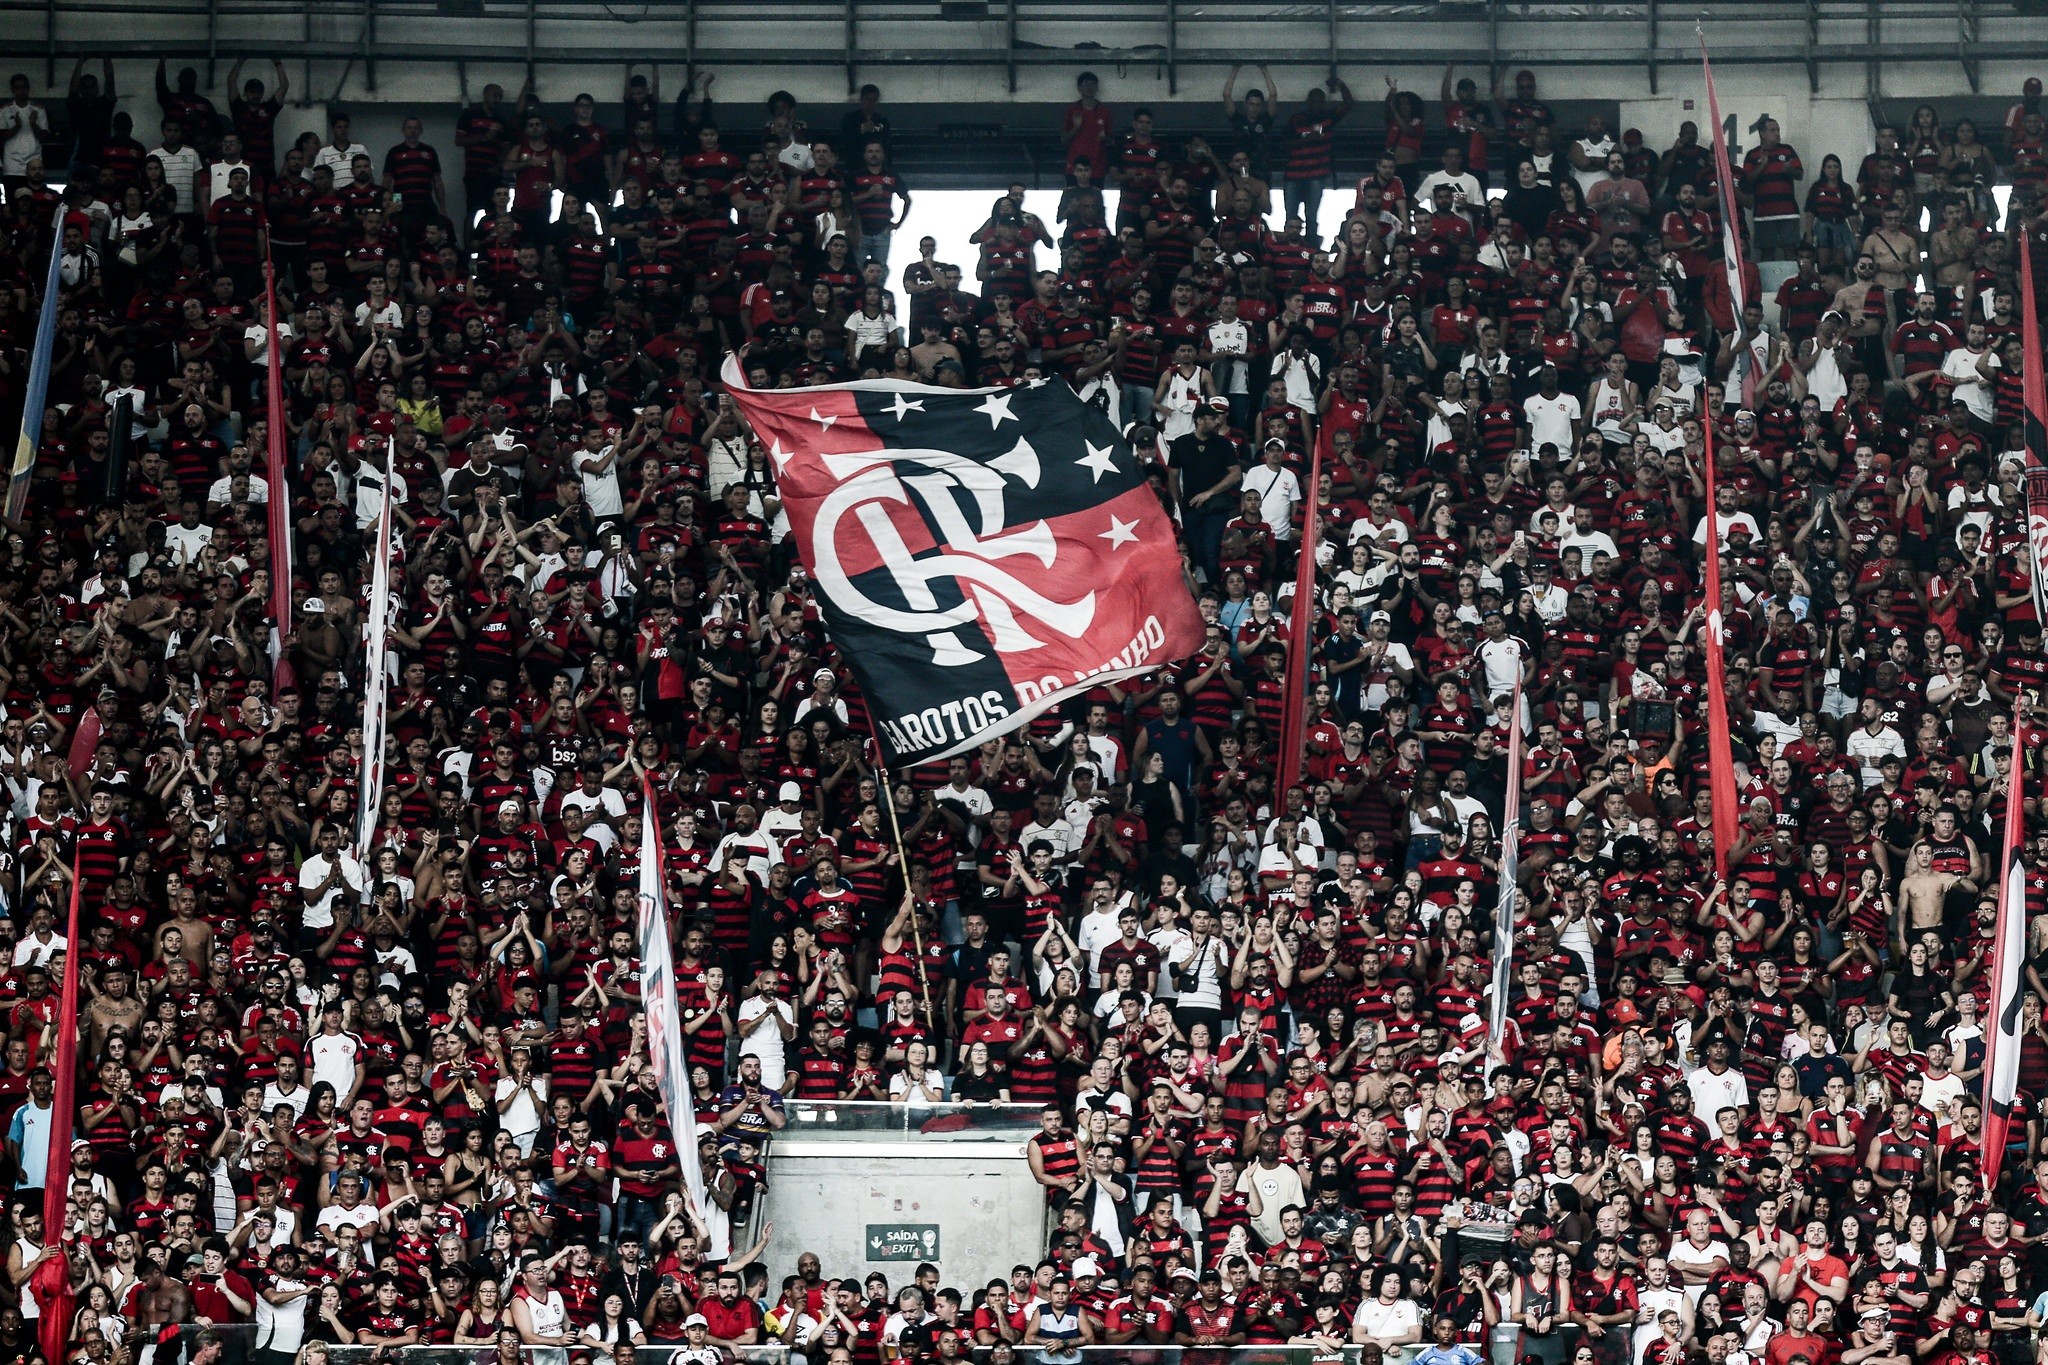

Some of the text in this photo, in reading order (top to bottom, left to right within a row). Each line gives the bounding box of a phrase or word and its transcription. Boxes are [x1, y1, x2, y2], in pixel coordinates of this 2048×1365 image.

[879, 690, 1010, 754] GAROTOS
[1074, 615, 1165, 682] NHO
[886, 1229, 919, 1241] SAÍDA
[891, 1244, 915, 1253] EXIT
